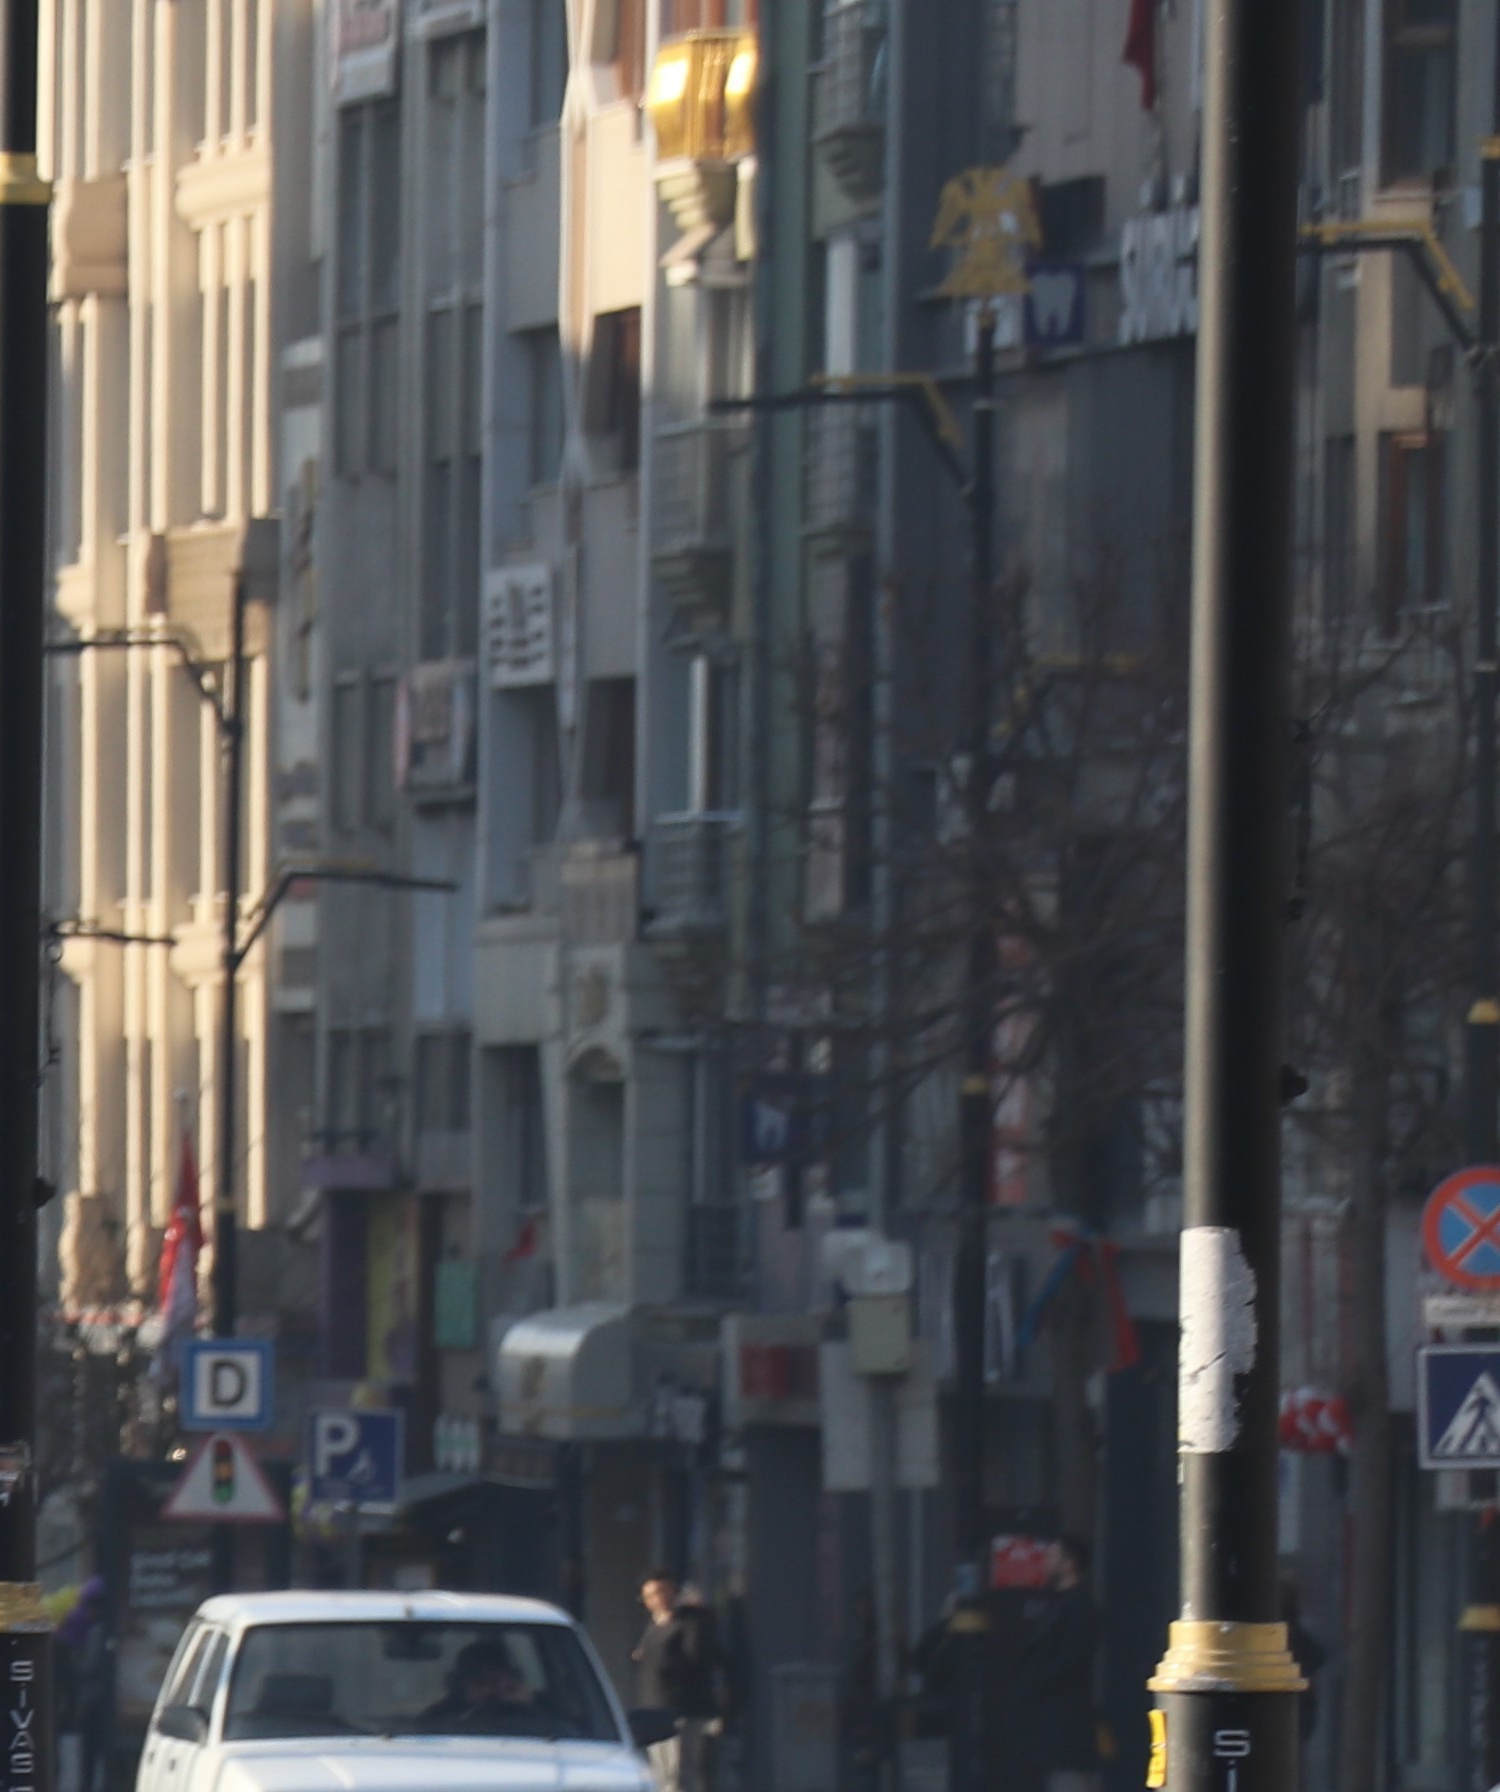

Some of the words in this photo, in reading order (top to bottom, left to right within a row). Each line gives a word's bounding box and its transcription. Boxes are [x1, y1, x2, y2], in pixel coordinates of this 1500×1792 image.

[210, 1359, 247, 1406] D
[314, 1415, 358, 1476] P
[9, 1660, 35, 1774] SİVAS
